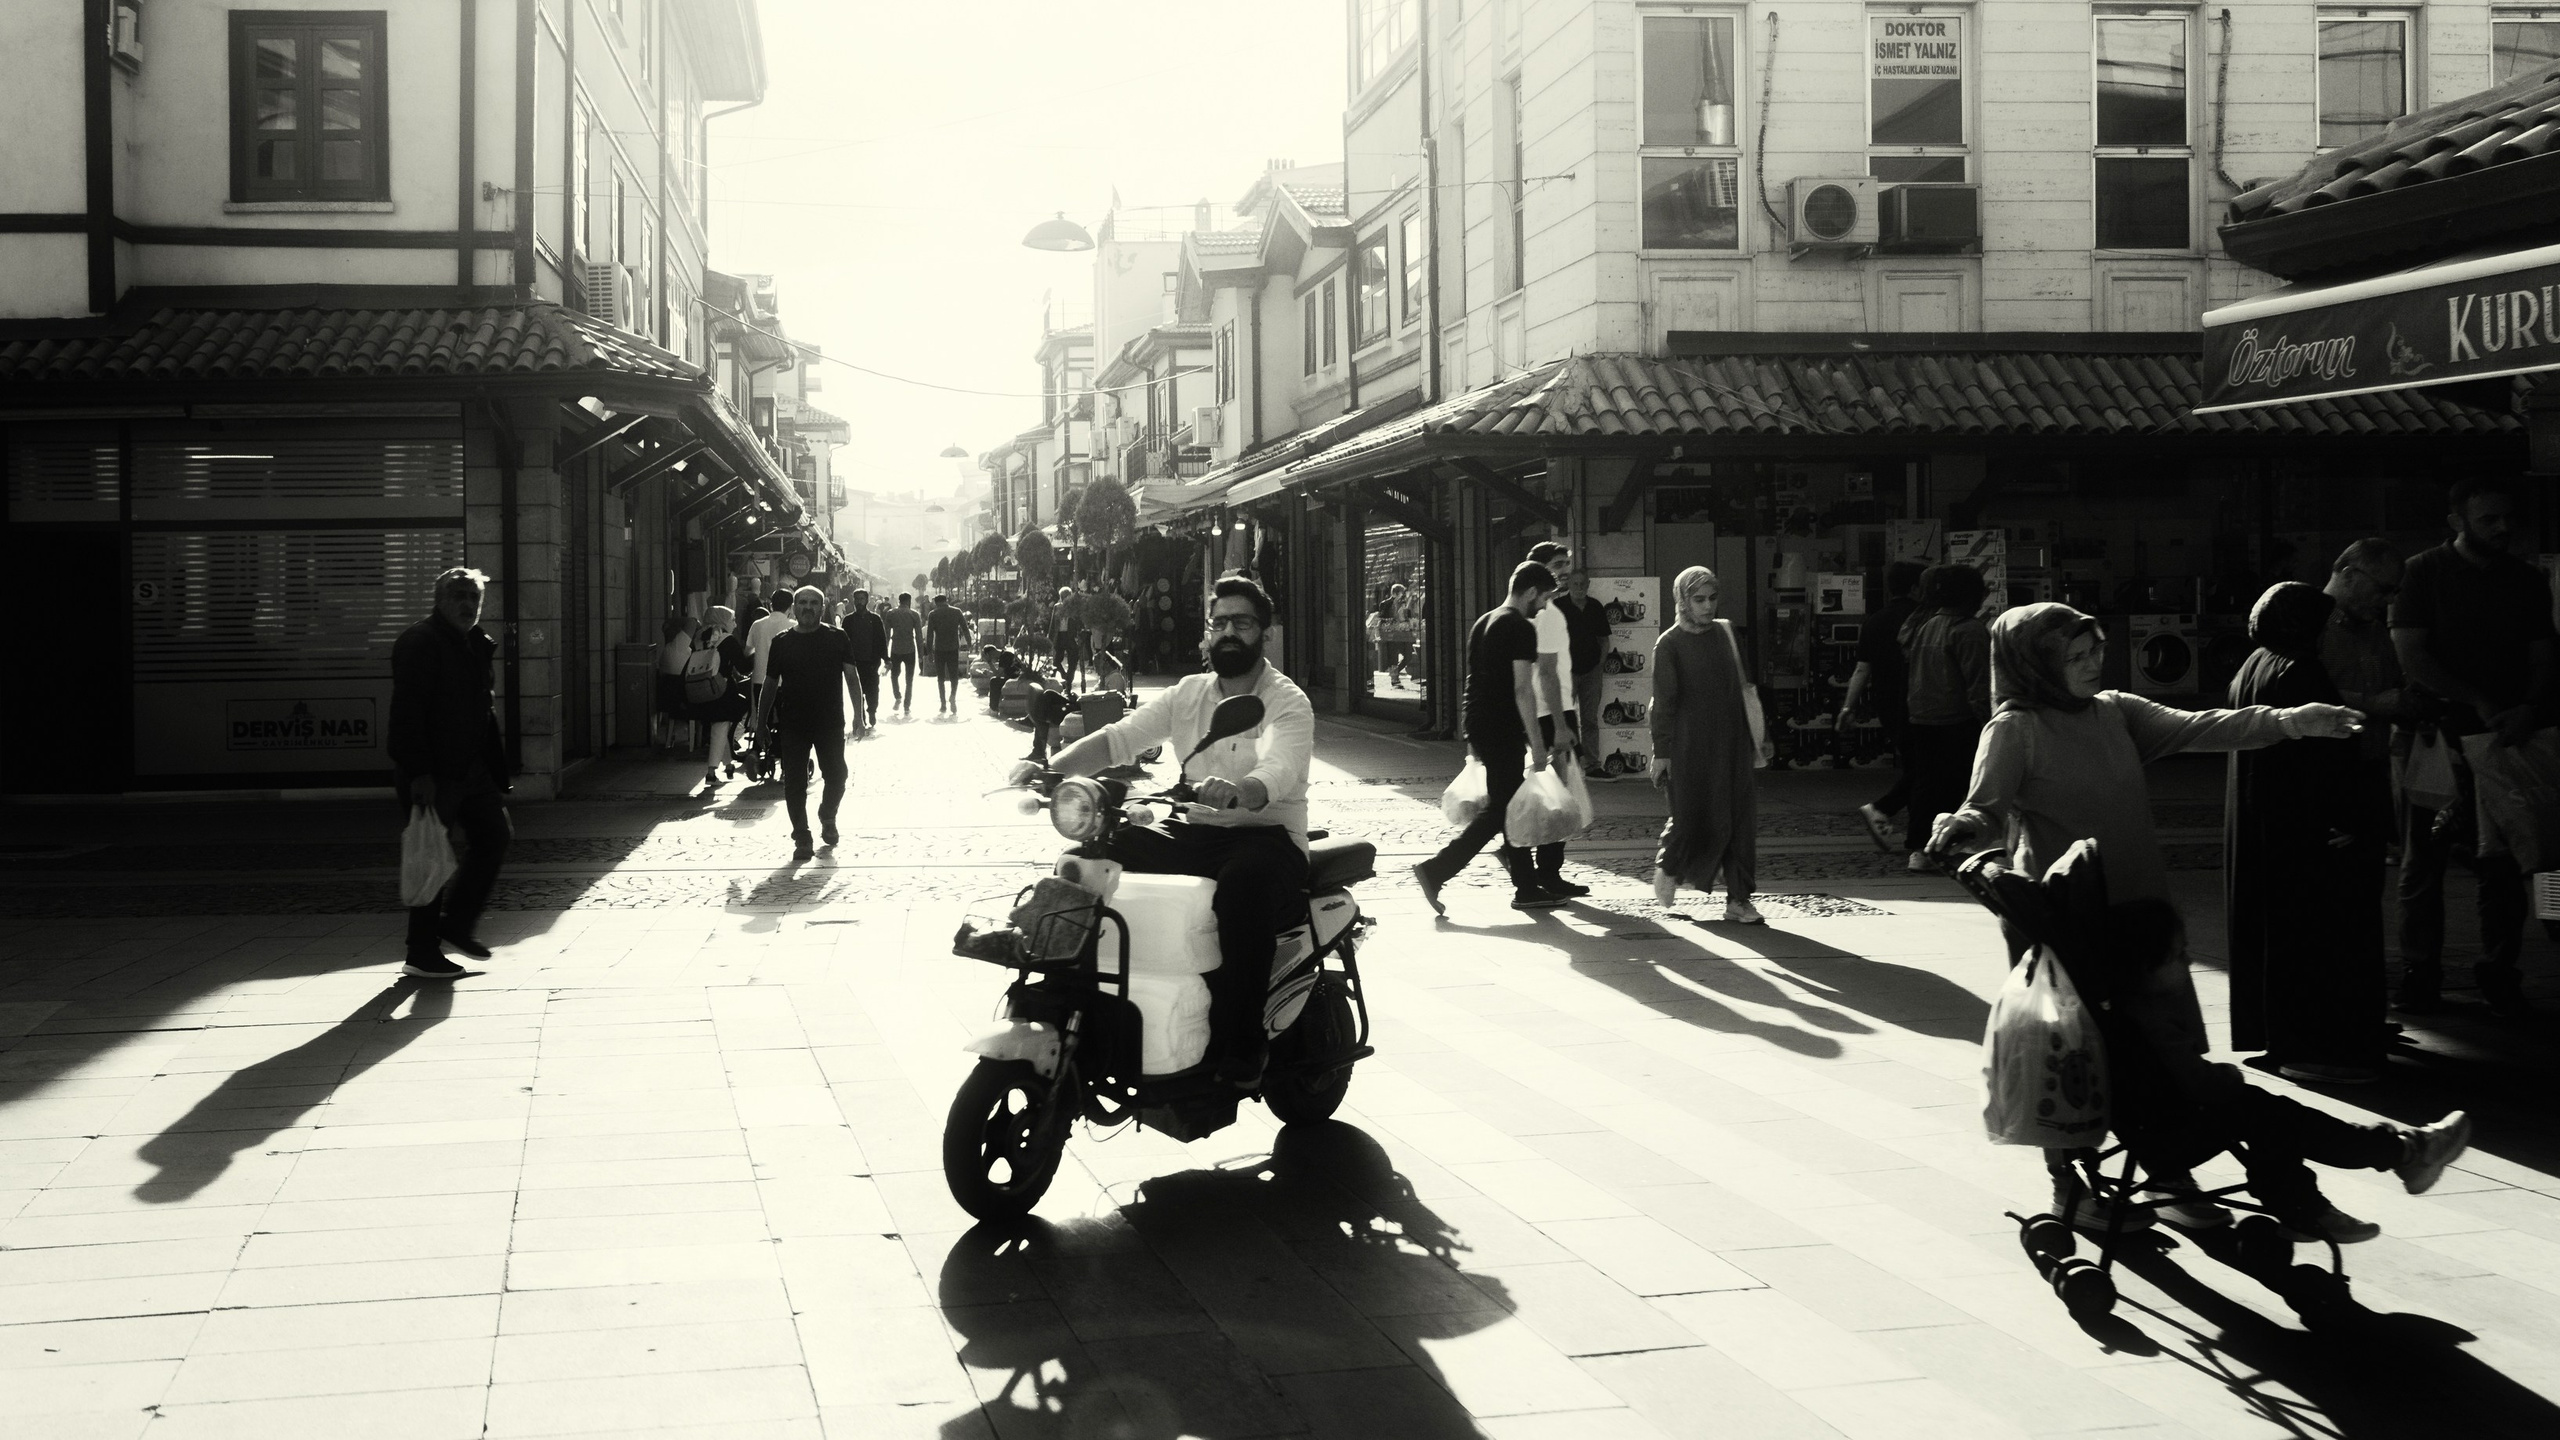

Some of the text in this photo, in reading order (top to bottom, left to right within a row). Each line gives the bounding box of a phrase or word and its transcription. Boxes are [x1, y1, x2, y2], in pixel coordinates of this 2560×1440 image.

[1885, 22, 1946, 37] DOKTOR
[1875, 38, 1957, 59] İSMET YALNIZ
[1874, 63, 1958, 77] İÇ HASTALIKLARI UZMANI
[2228, 284, 2560, 387] Öztorun KURU
[139, 582, 153, 598] S
[320, 719, 369, 737] NAR
